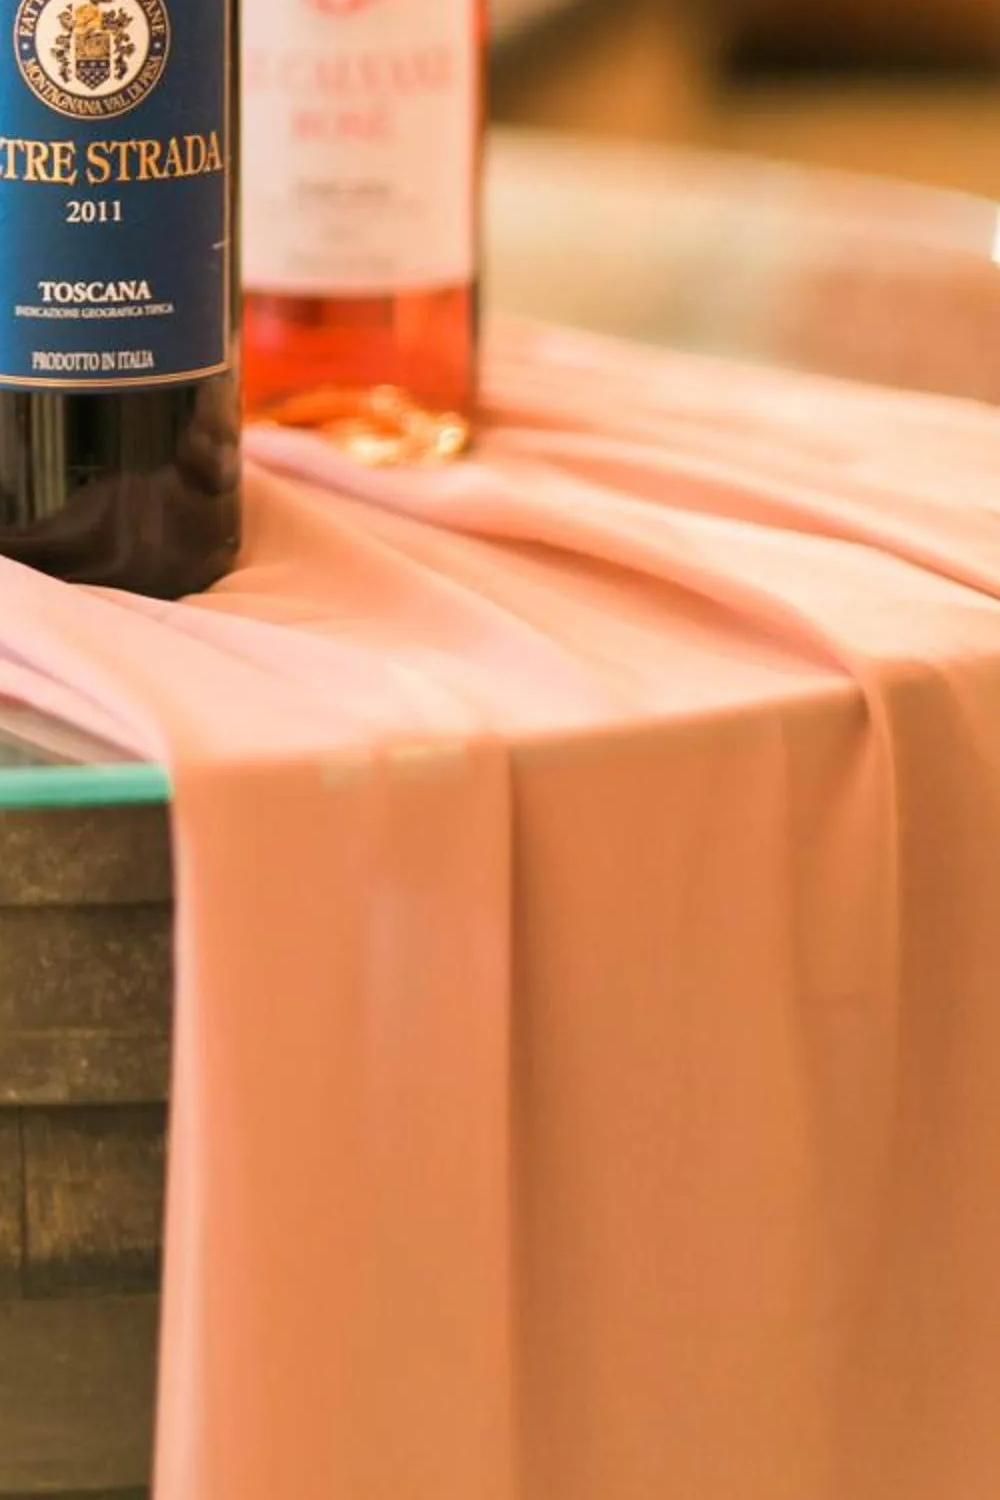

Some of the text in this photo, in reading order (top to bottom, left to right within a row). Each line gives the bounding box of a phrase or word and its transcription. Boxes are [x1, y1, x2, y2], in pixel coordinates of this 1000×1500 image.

[85, 131, 224, 184] STRADA
[65, 200, 122, 223] 2011
[38, 280, 152, 303] TOSCANA
[32, 350, 154, 371] PRODOTTO IN ITALIA
